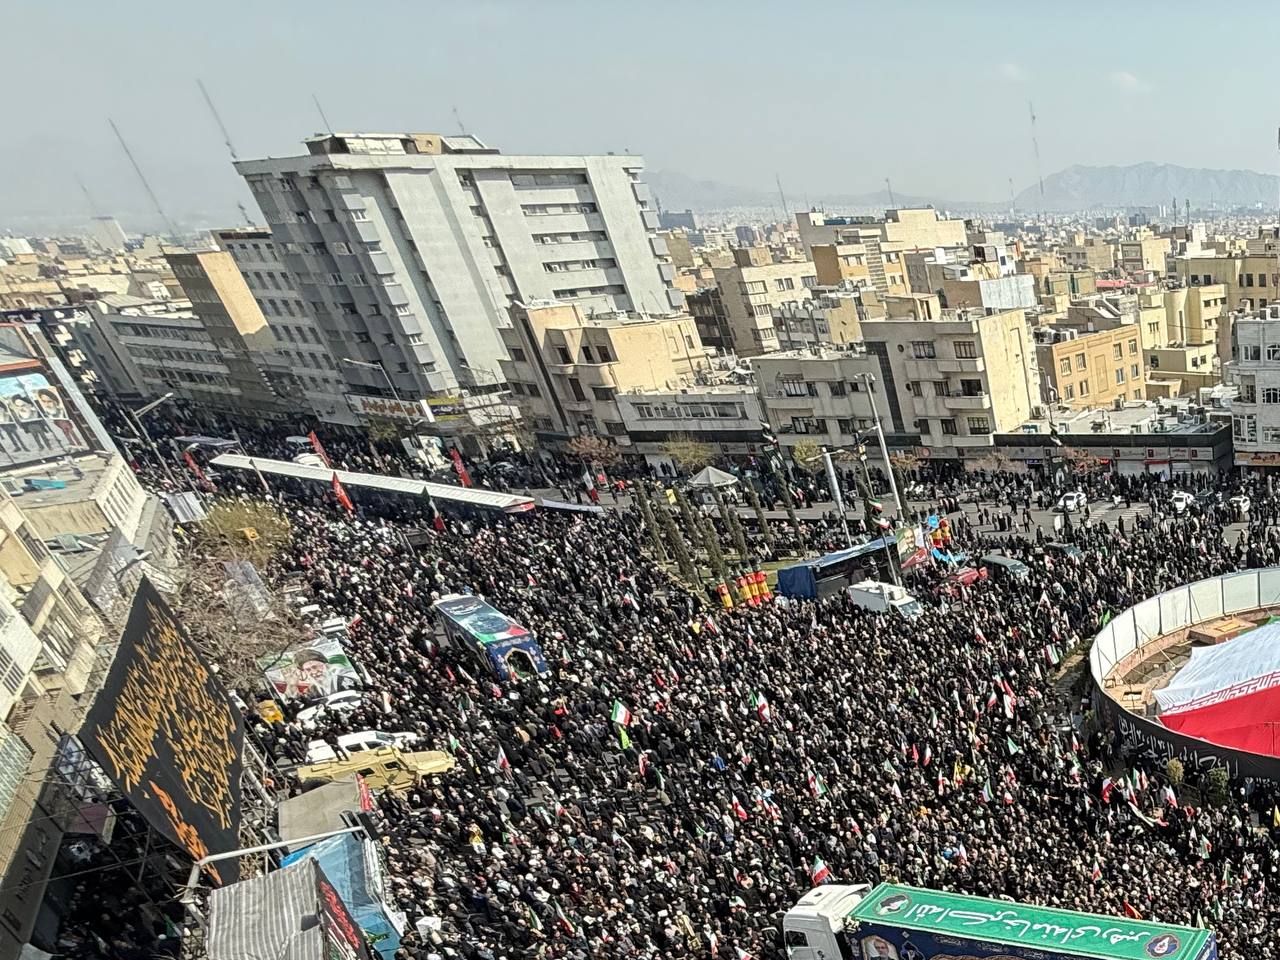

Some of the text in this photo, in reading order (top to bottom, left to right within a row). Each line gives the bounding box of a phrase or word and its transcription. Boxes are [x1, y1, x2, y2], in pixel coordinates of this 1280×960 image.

[904, 903, 943, 922] الله
[937, 906, 1018, 926] اکبر
[1100, 925, 1153, 945] رهبر
